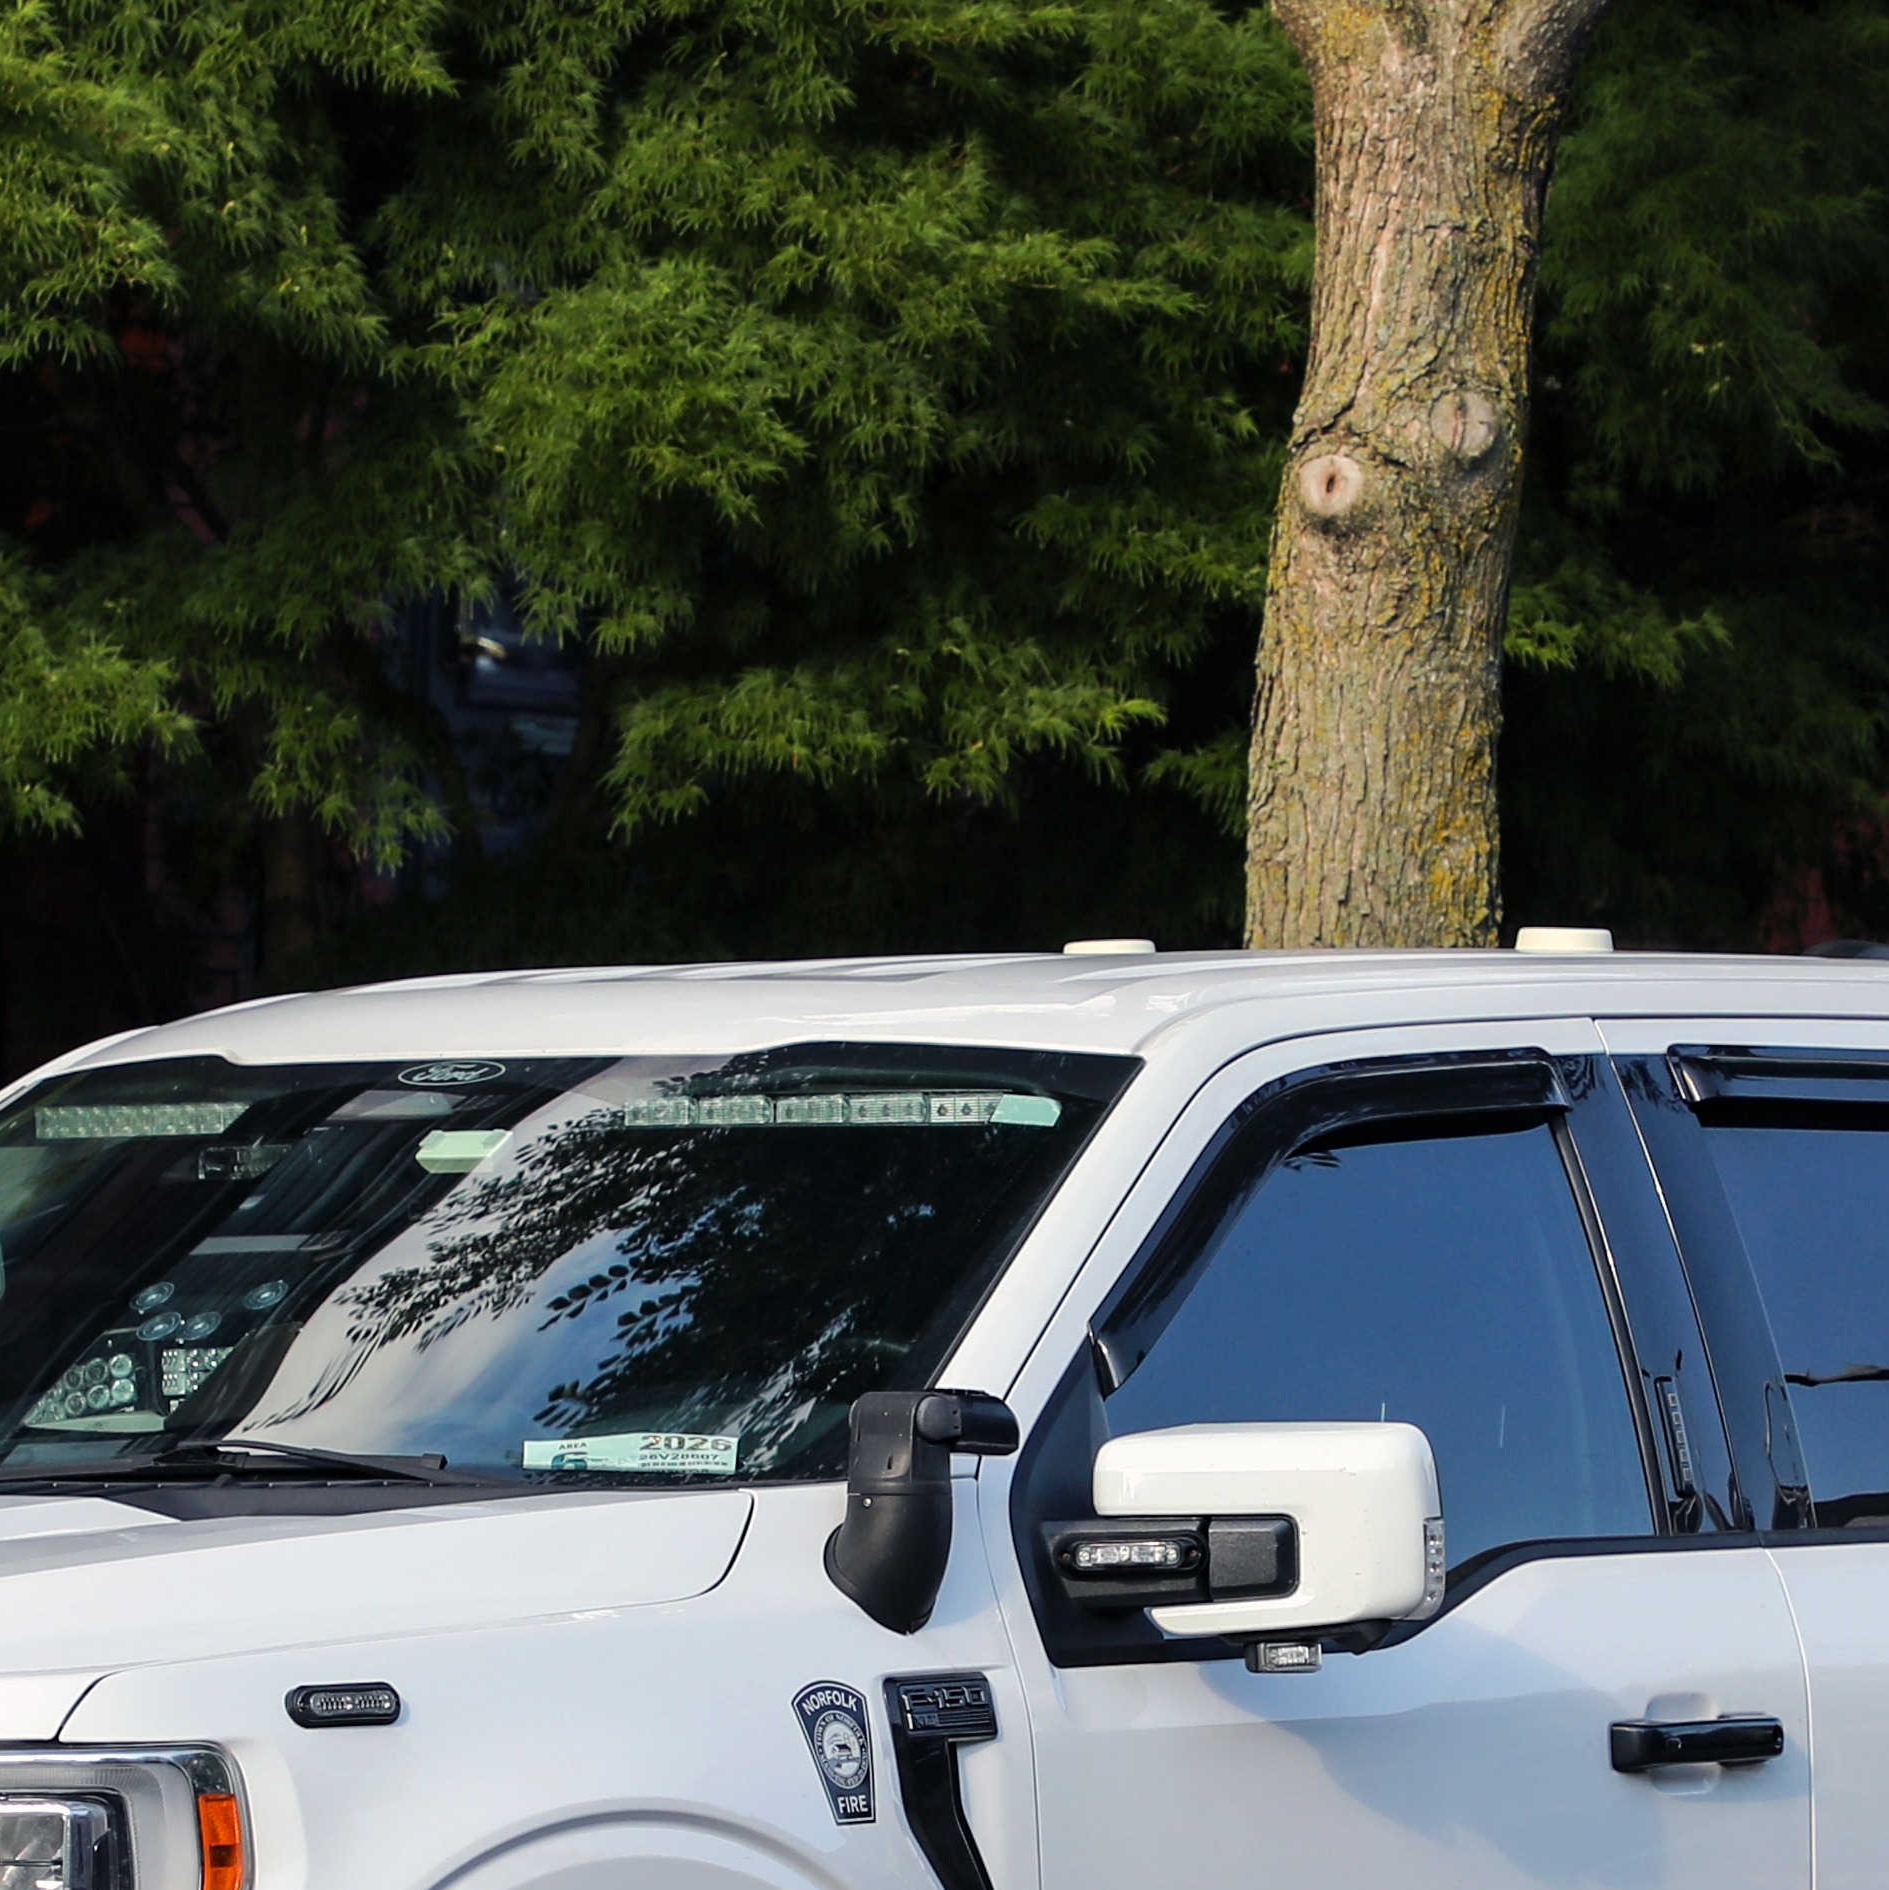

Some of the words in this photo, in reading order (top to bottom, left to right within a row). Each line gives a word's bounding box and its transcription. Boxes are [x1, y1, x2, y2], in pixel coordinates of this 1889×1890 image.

[412, 1064, 490, 1081] Ford
[558, 1442, 588, 1451] AREA
[639, 1435, 733, 1452] 2026
[802, 1690, 857, 1716] NORFOLK
[837, 1794, 868, 1814] FIRE
